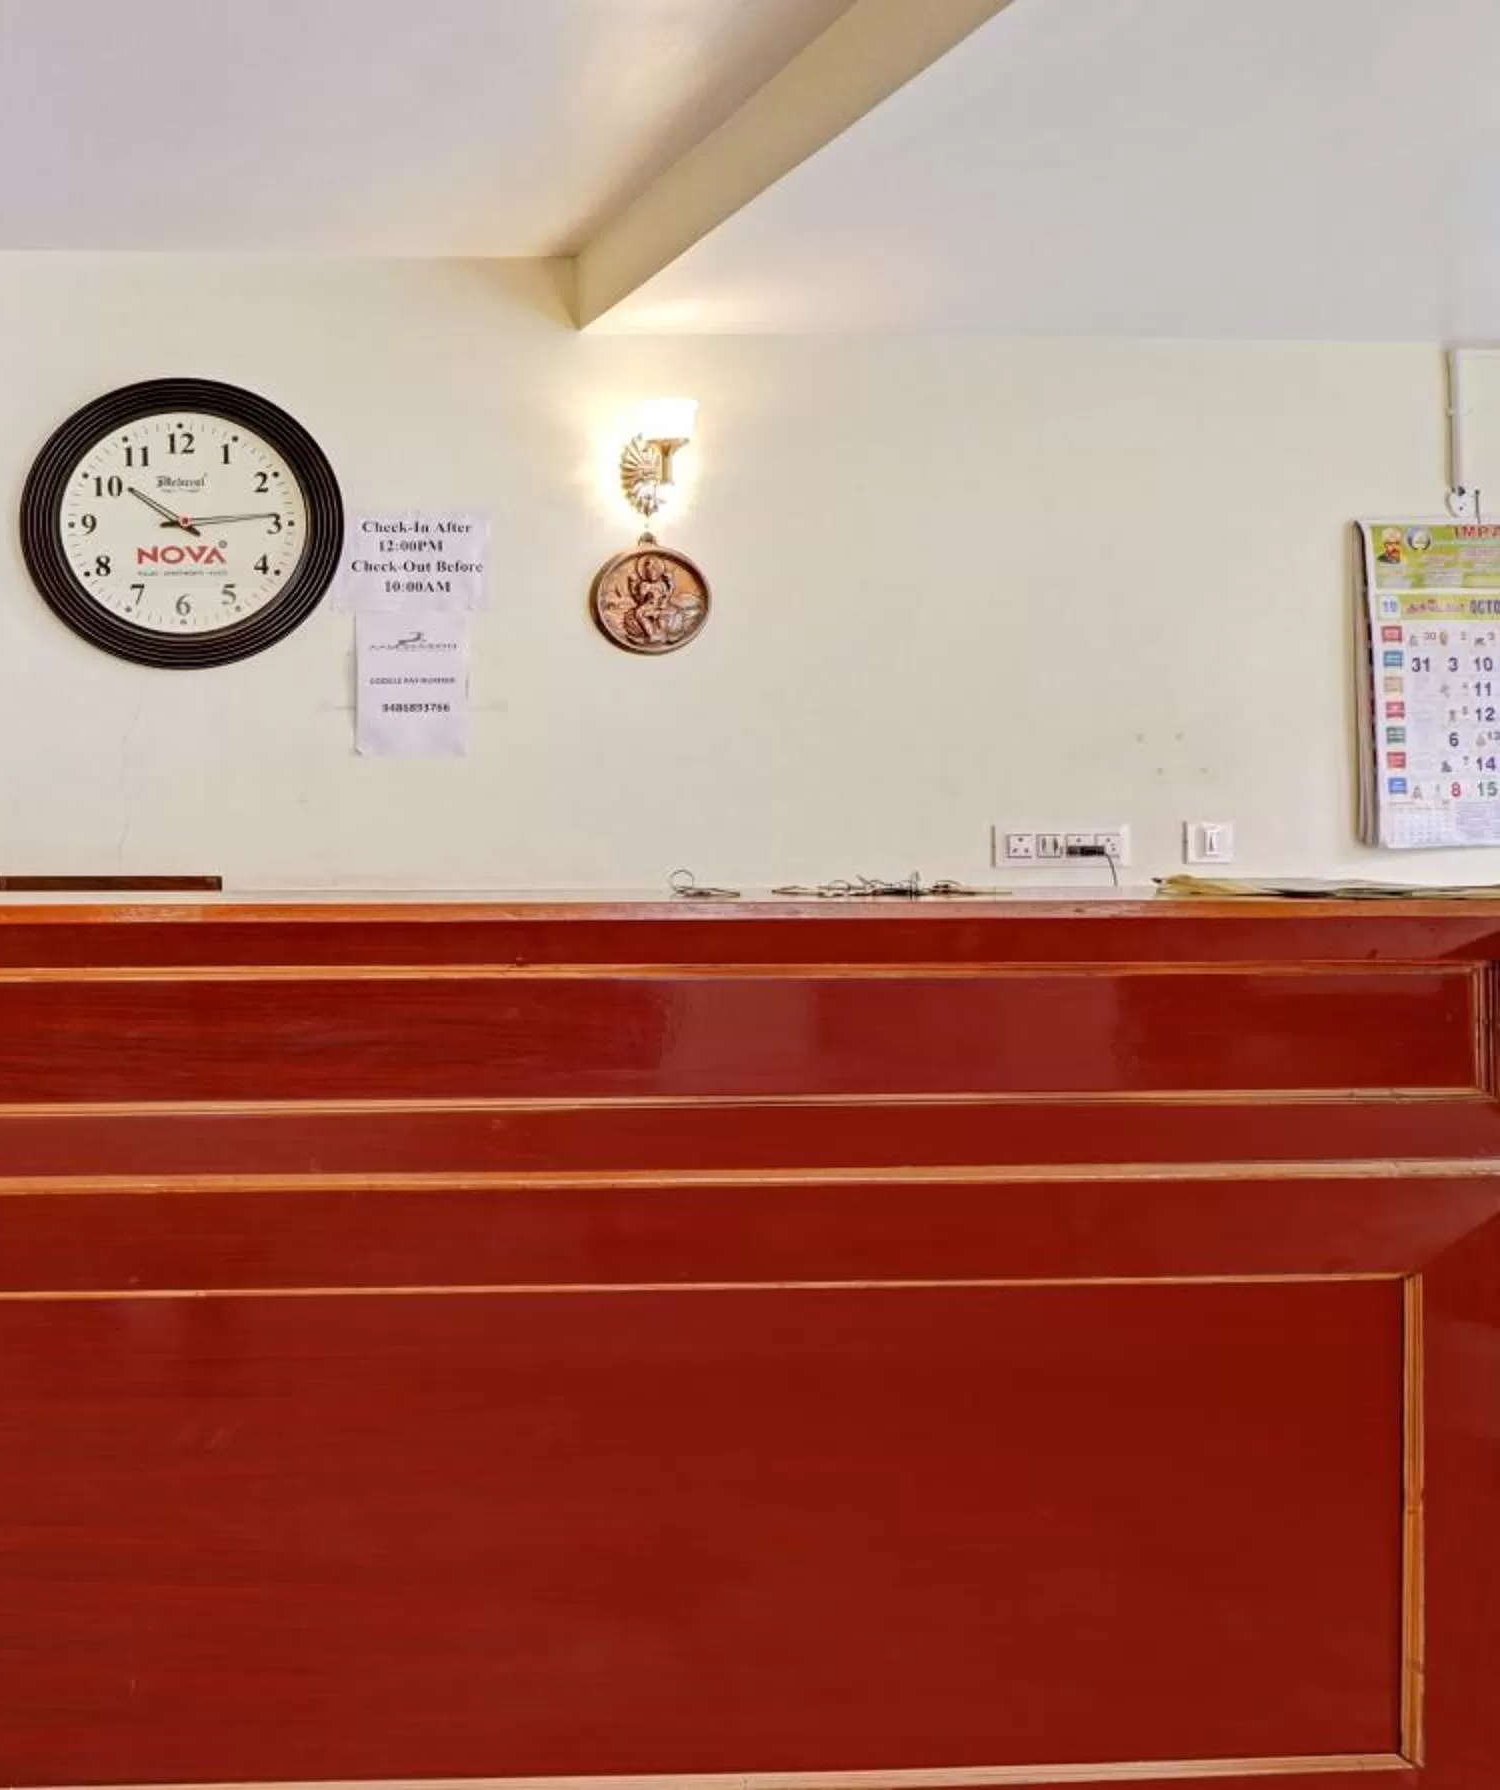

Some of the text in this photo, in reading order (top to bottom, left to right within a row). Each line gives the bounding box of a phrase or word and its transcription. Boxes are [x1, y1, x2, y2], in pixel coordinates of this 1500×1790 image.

[166, 433, 196, 455] 12
[221, 443, 231, 464] 1
[124, 446, 150, 467] 11
[92, 475, 123, 498] 10
[254, 471, 269, 493] 2
[80, 513, 97, 535] 9
[267, 513, 282, 535] 3
[361, 520, 473, 534] Check-In After
[136, 545, 227, 565] NOVA
[379, 540, 443, 552] 12:00PM
[95, 555, 111, 577] 8
[253, 553, 269, 576] 4
[351, 559, 484, 573] Check-Out Before
[130, 583, 146, 606] 7
[222, 583, 237, 606] 5
[385, 580, 451, 593] 10:00AM
[175, 593, 191, 617] 6
[1411, 656, 1431, 673] 31
[1448, 656, 1459, 673] 3
[1474, 656, 1493, 673] 10
[1475, 681, 1492, 697] 11
[1476, 706, 1496, 722] 12
[1449, 732, 1460, 748] 6
[1476, 756, 1497, 772] 14
[1451, 781, 1462, 798] 8
[1478, 781, 1498, 798] 15
